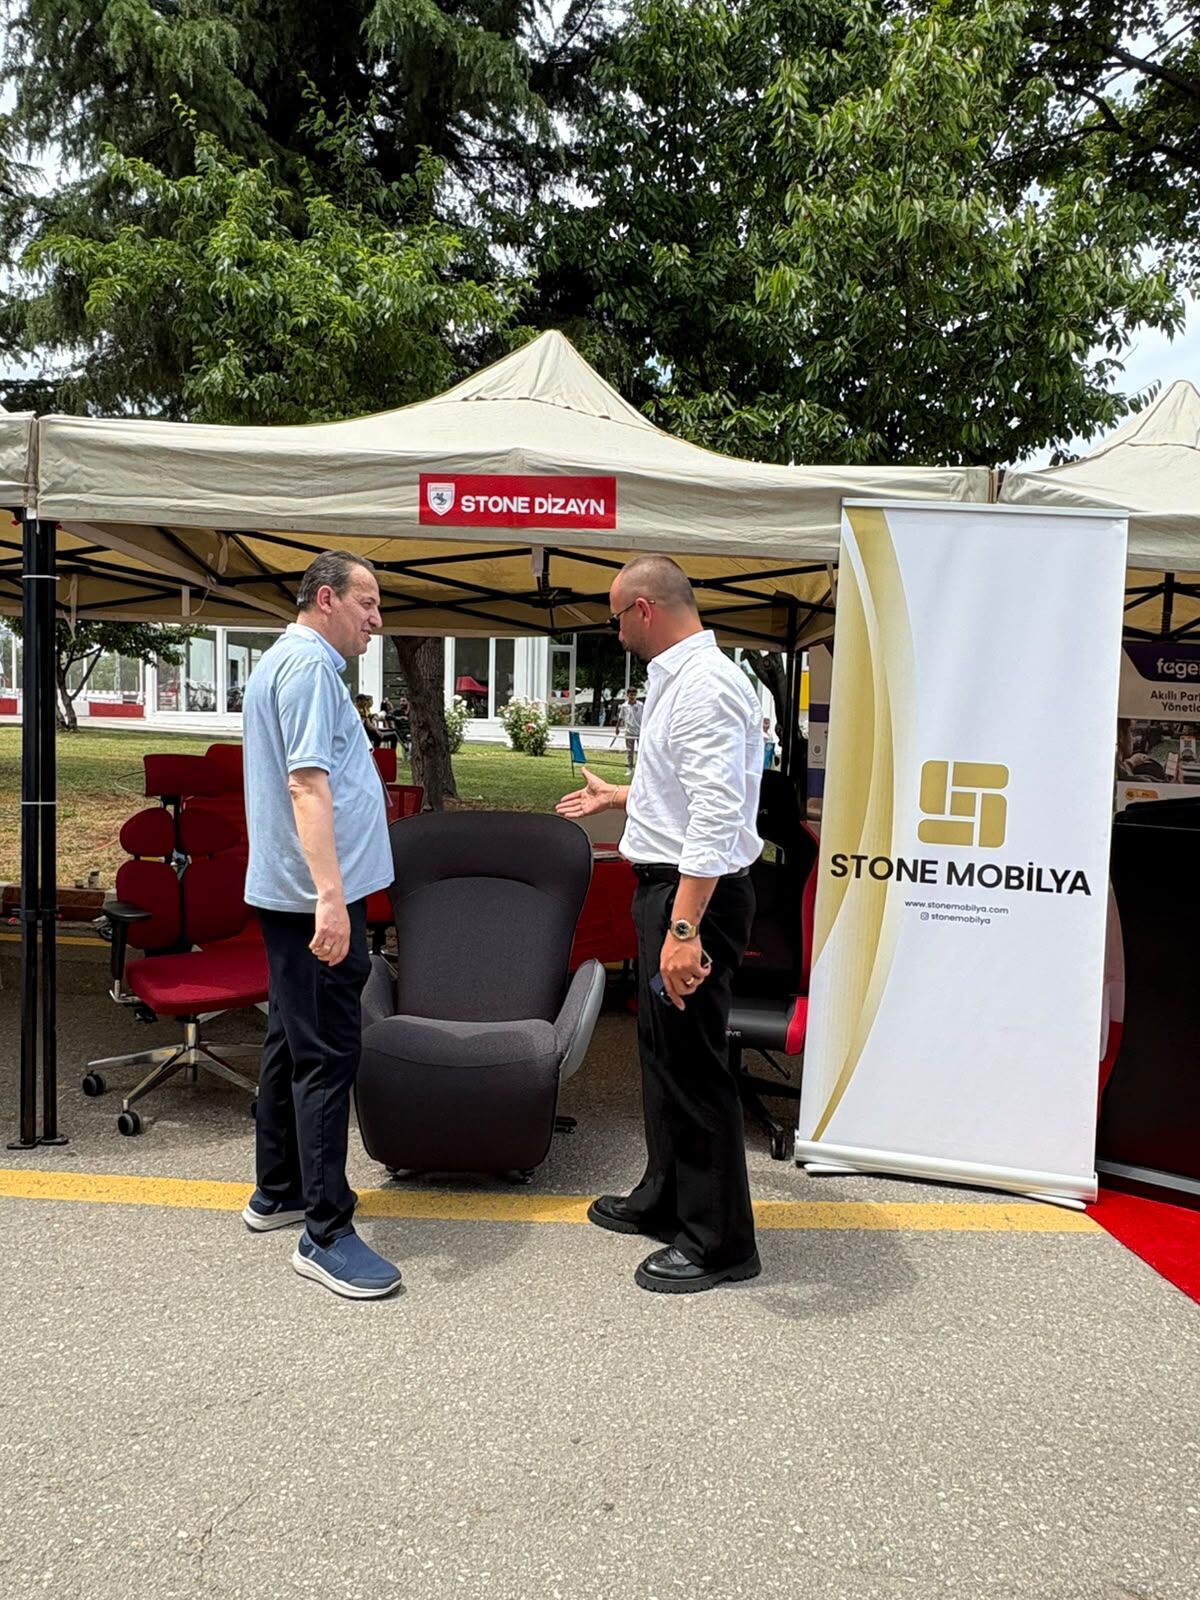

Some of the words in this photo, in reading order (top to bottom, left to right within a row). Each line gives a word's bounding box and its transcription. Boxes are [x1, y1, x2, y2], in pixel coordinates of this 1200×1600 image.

[461, 495, 530, 513] STONE
[534, 494, 605, 515] DİZAYN
[830, 853, 938, 884] STONE
[946, 862, 1092, 896] MOBİLYA
[904, 900, 1009, 915] www.stonemobilya.com
[931, 913, 991, 925] stonemobilya
